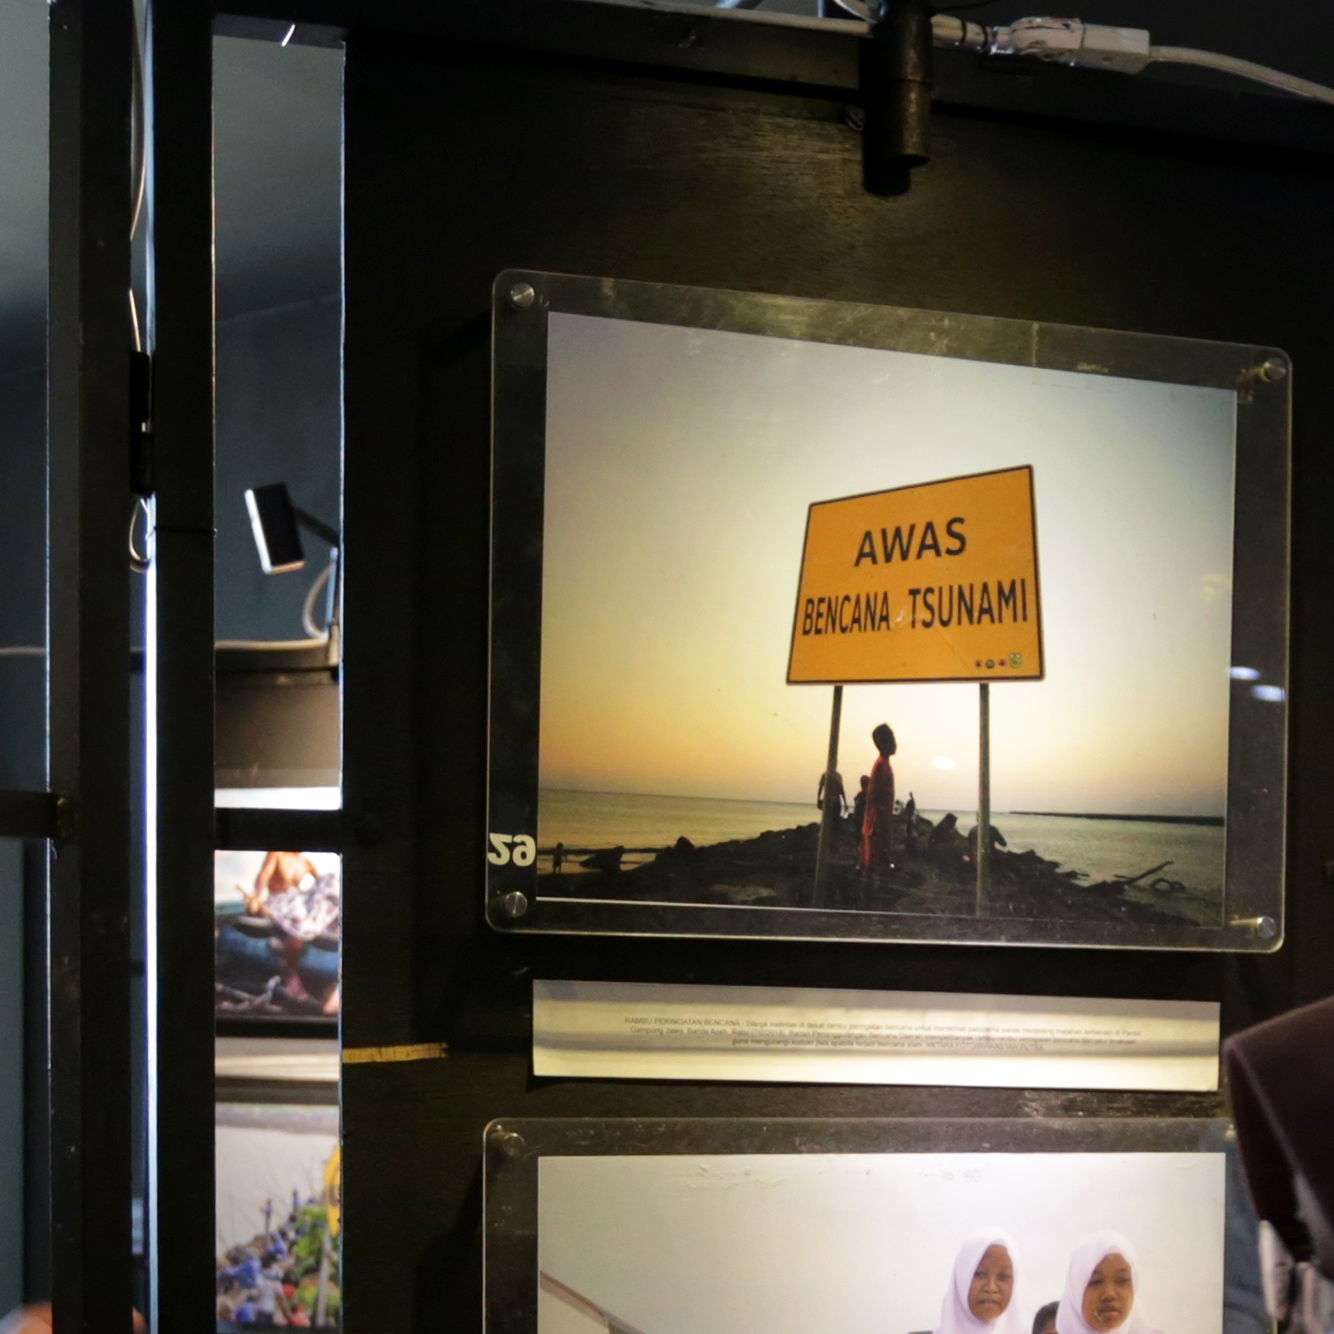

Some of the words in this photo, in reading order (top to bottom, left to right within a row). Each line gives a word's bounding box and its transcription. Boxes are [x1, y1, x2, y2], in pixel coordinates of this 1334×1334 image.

[854, 517, 967, 567] AWAS
[802, 591, 890, 636] BENCANA
[908, 578, 1028, 629] TSUNAMI
